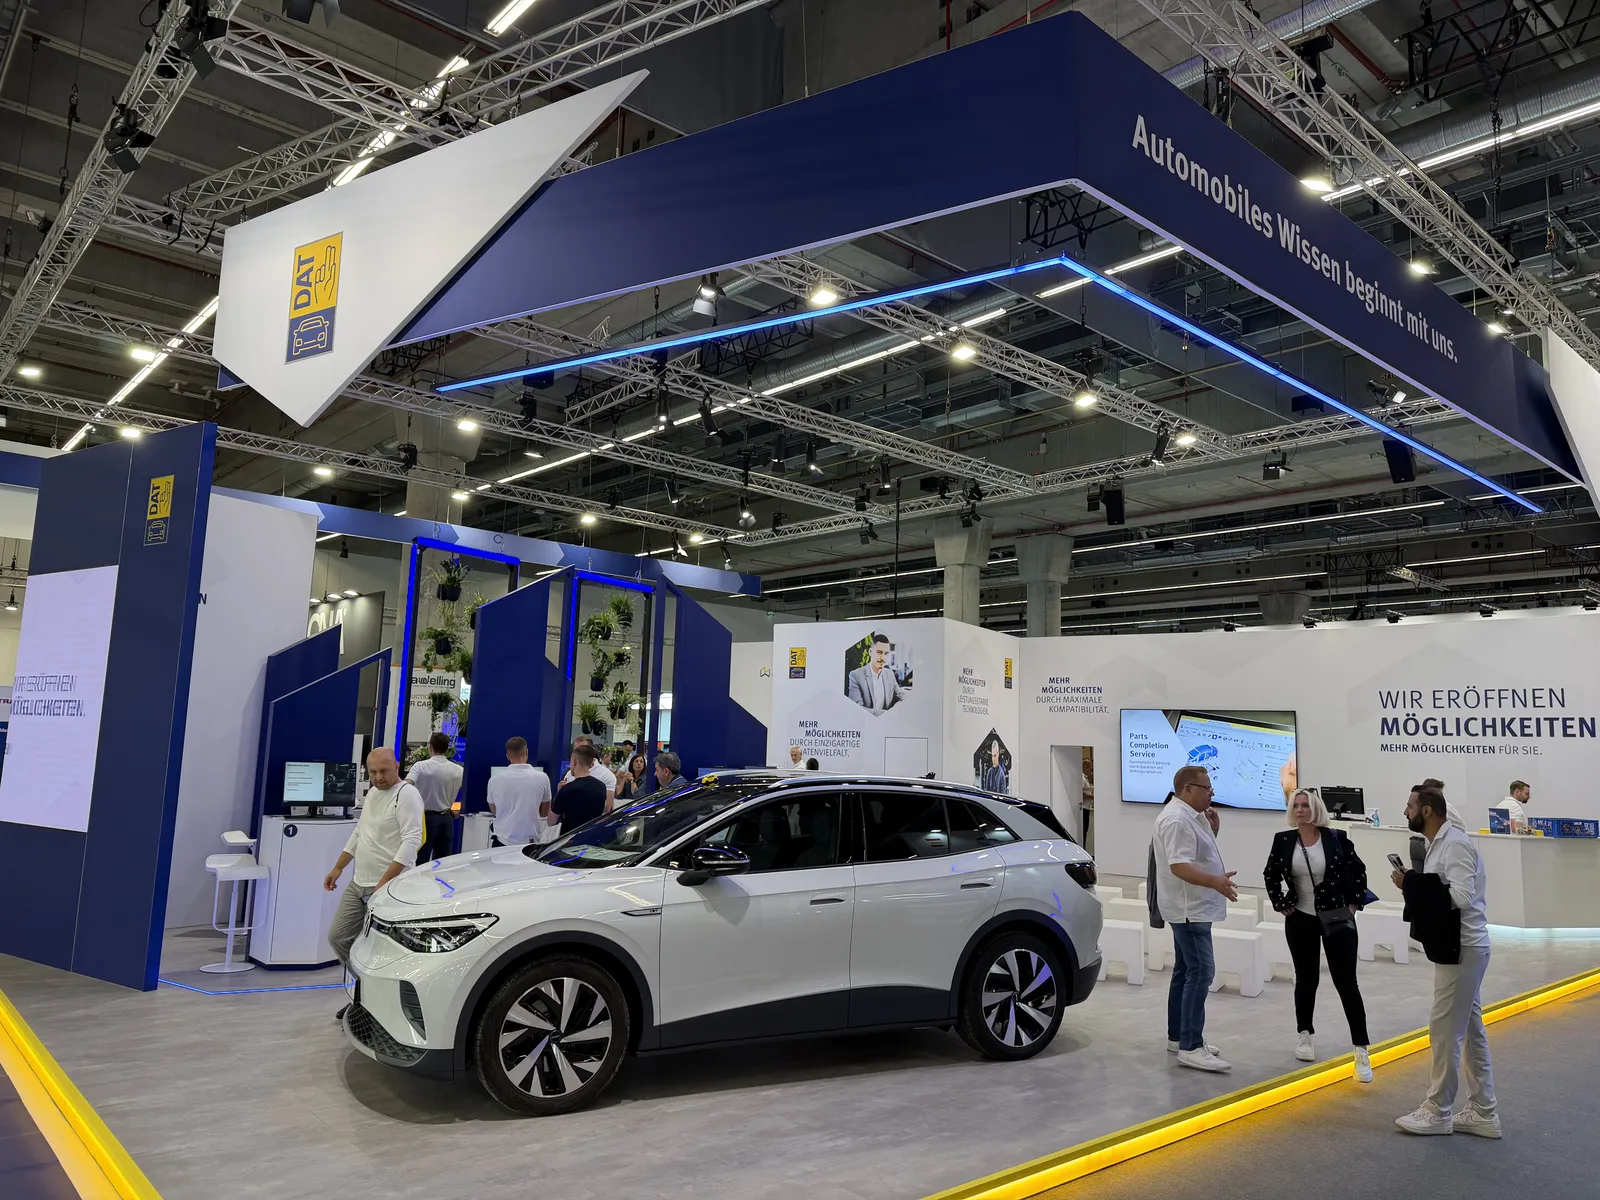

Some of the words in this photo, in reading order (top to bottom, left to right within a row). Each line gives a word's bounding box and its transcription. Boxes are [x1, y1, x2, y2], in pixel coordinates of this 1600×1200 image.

[1132, 114, 1273, 239] Automobiles
[1277, 213, 1341, 285] Wissen
[1345, 261, 1404, 327] beginnt
[1407, 311, 1429, 344] mit
[1431, 327, 1458, 364] uns.
[293, 254, 315, 311] DAT
[149, 483, 160, 516] DAT
[1041, 685, 1103, 694] MÖGLICHKEITEN
[1036, 696, 1061, 704] DURCH
[1063, 696, 1103, 704] MAXIMALE
[1378, 690, 1423, 709] WIR
[1432, 685, 1566, 709] ERÖFFNEN
[1048, 705, 1109, 714] KOMPATIBILITÄT.
[1380, 712, 1597, 738] MÖGLICHKEITEN
[805, 730, 861, 738] MÖGLICHKEITEN
[1129, 732, 1148, 740] Parts
[815, 740, 861, 748] EINZIGARTIGE
[1129, 741, 1169, 750] Completion
[802, 749, 850, 757] ATENVIELFALT.
[1380, 744, 1409, 753] MEHR
[1411, 742, 1496, 755] MÖGLICHKEITEN
[1499, 744, 1519, 755] FÜR
[1522, 746, 1543, 756] SIE.
[1129, 750, 1156, 758] Service
[288, 826, 293, 836] 1
